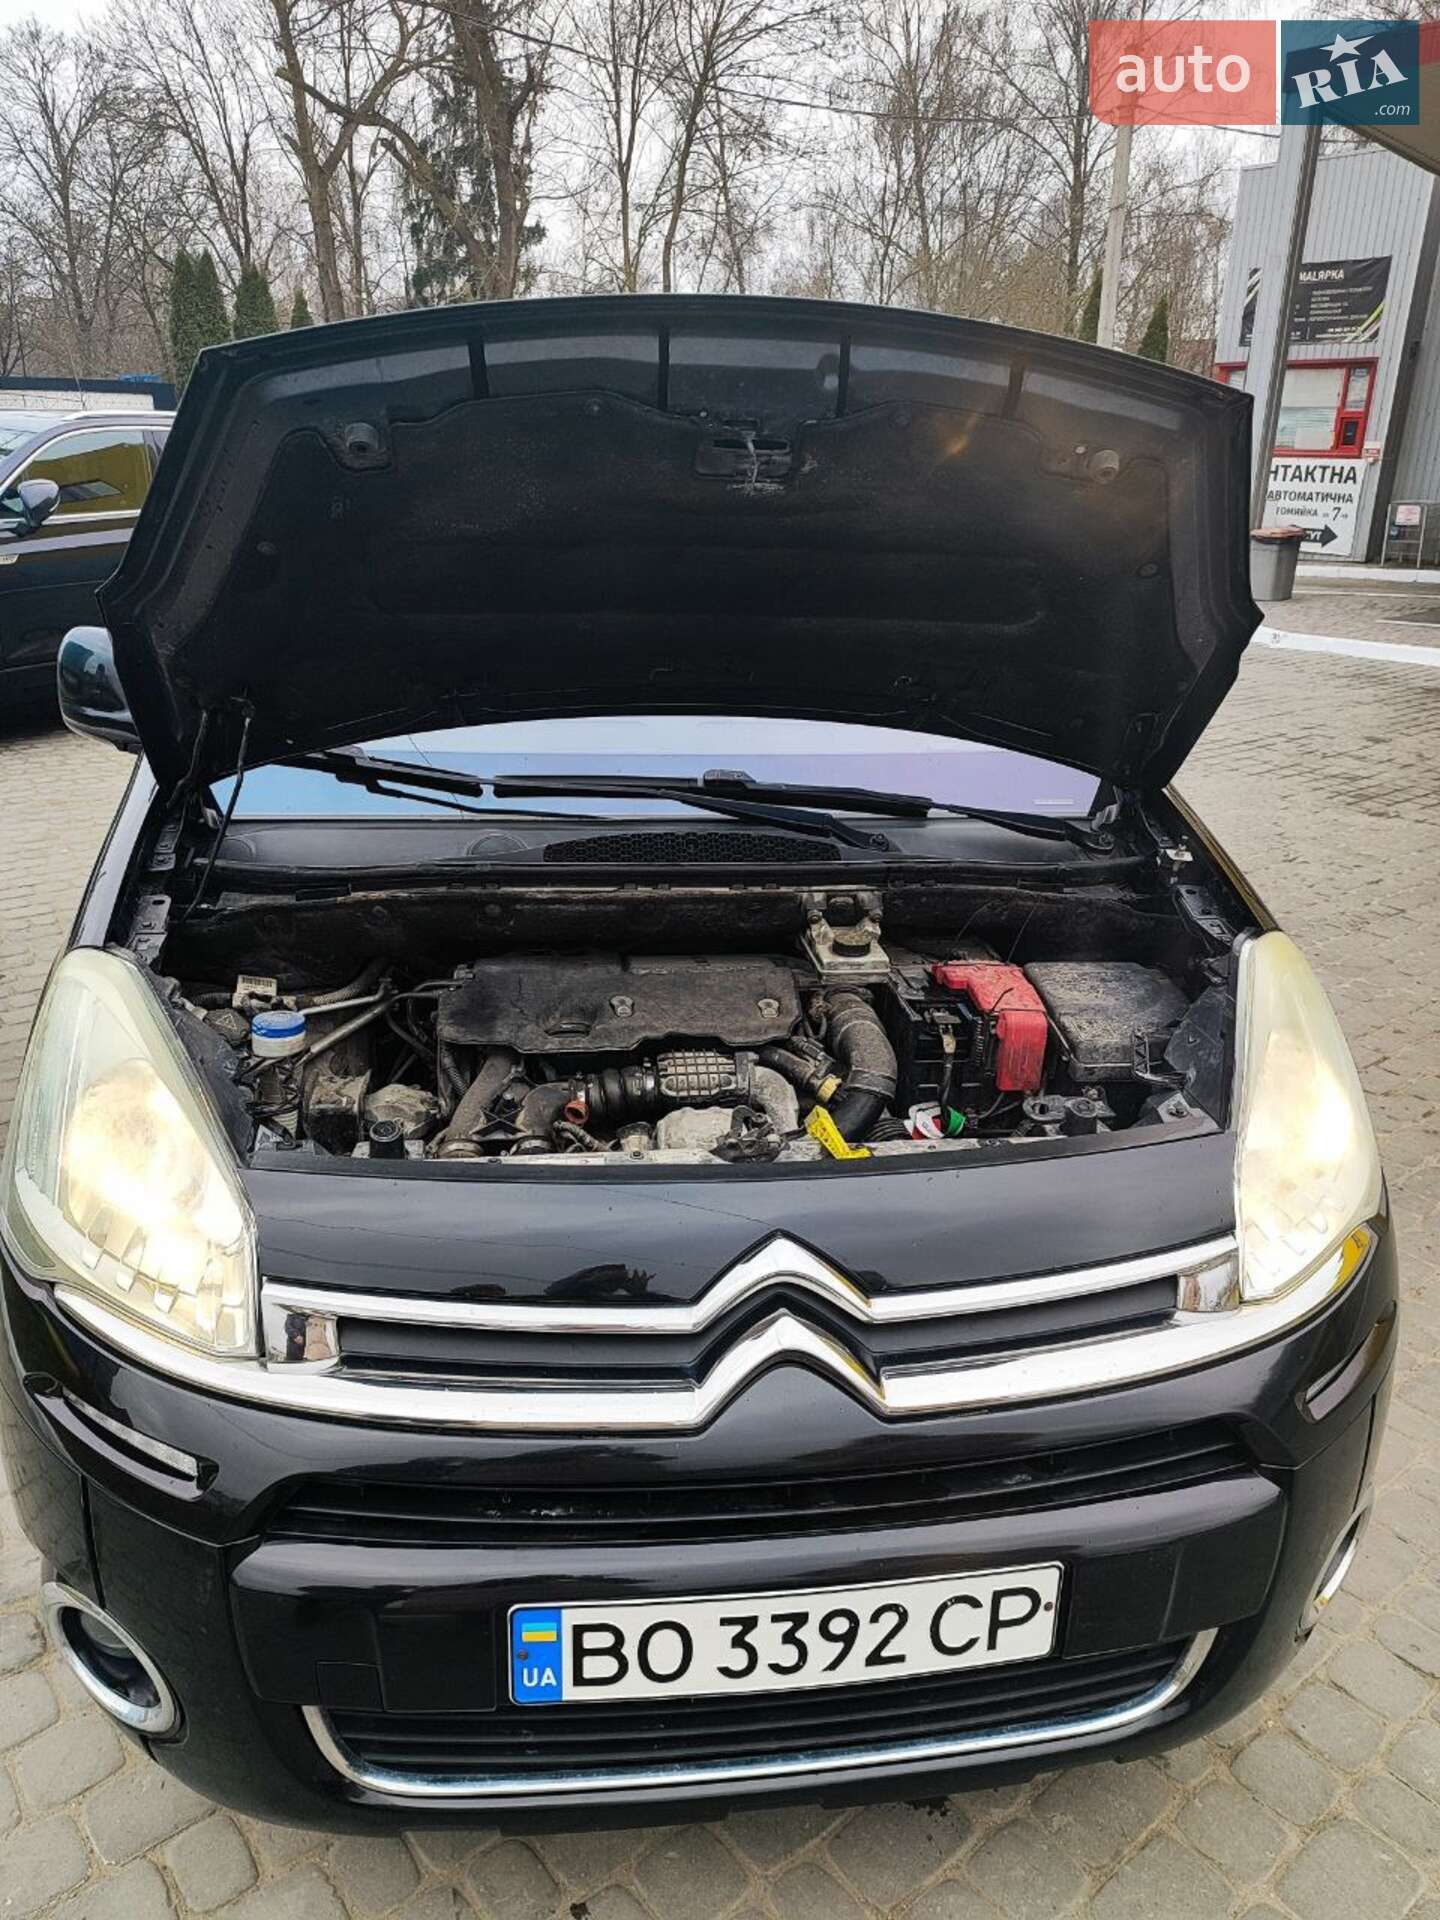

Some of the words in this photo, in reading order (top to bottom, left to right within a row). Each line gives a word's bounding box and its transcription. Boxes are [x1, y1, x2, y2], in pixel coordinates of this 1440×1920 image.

[572, 1621, 693, 1687] BO
[717, 1603, 909, 1680] 3392
[930, 1586, 1042, 1656] CP
[523, 1667, 557, 1687] UA
